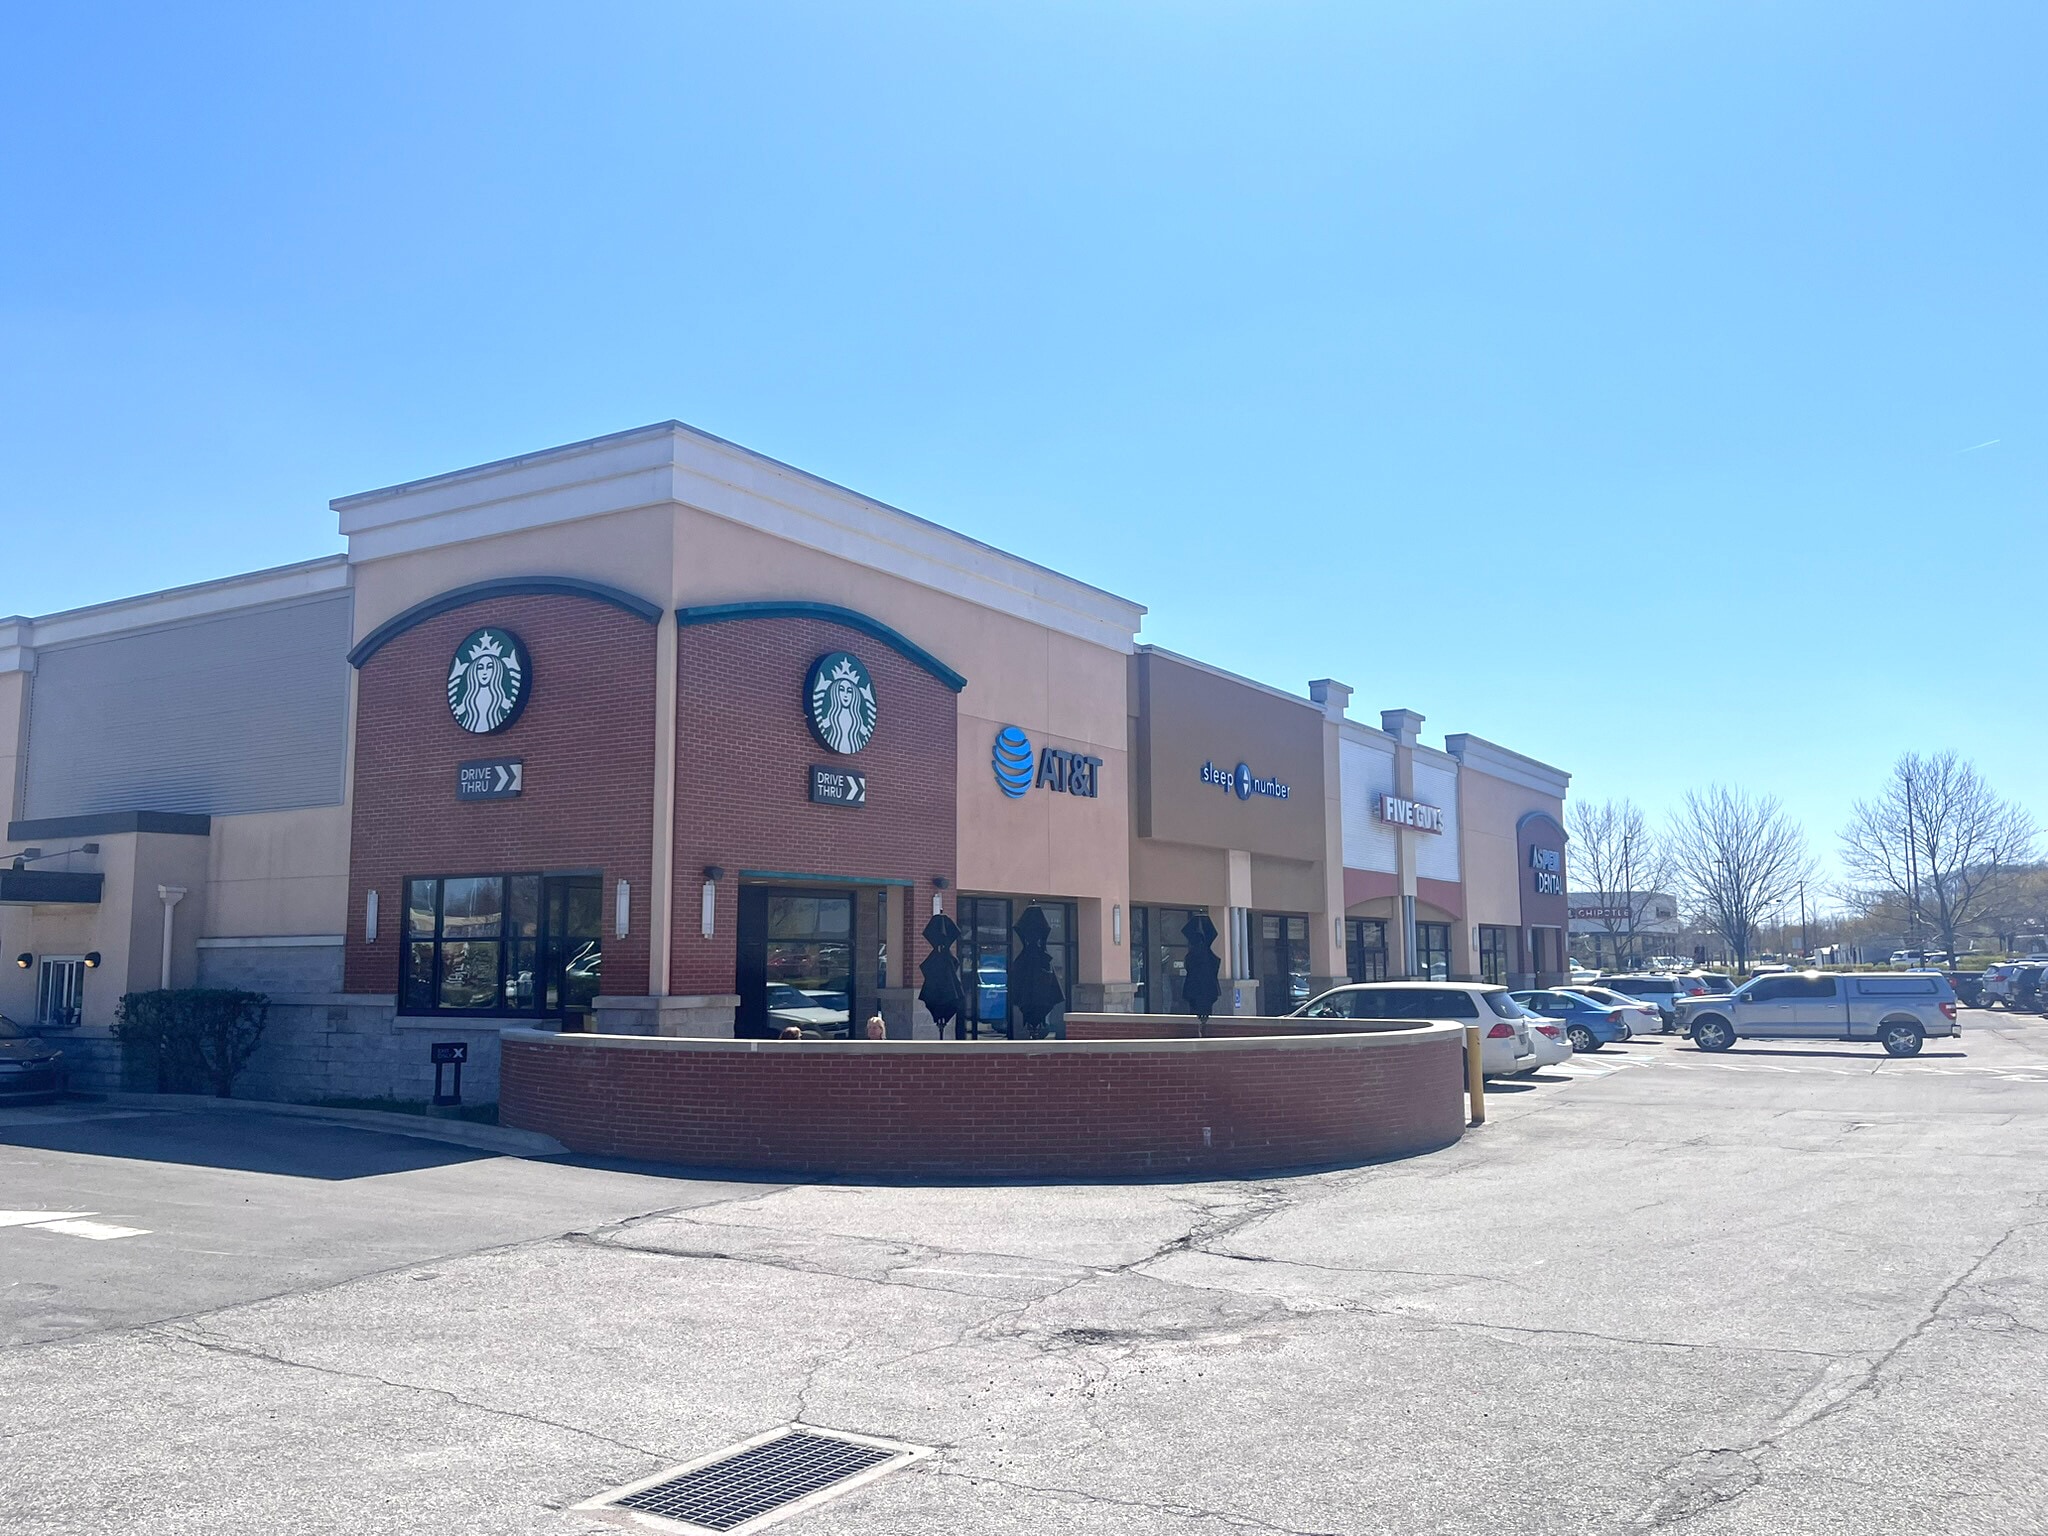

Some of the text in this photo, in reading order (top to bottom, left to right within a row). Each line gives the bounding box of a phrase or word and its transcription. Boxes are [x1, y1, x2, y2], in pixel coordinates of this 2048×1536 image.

[461, 767, 491, 781] DRIVE
[817, 771, 844, 787] DRIVE
[1036, 747, 1103, 798] AT&T
[1201, 761, 1290, 799] sleep number
[461, 780, 489, 793] THRU
[817, 784, 843, 799] THRU
[1386, 796, 1443, 832] FIVE GUYS
[1537, 872, 1564, 896] DENTAL
[1578, 909, 1629, 917] CHIPOTLE
